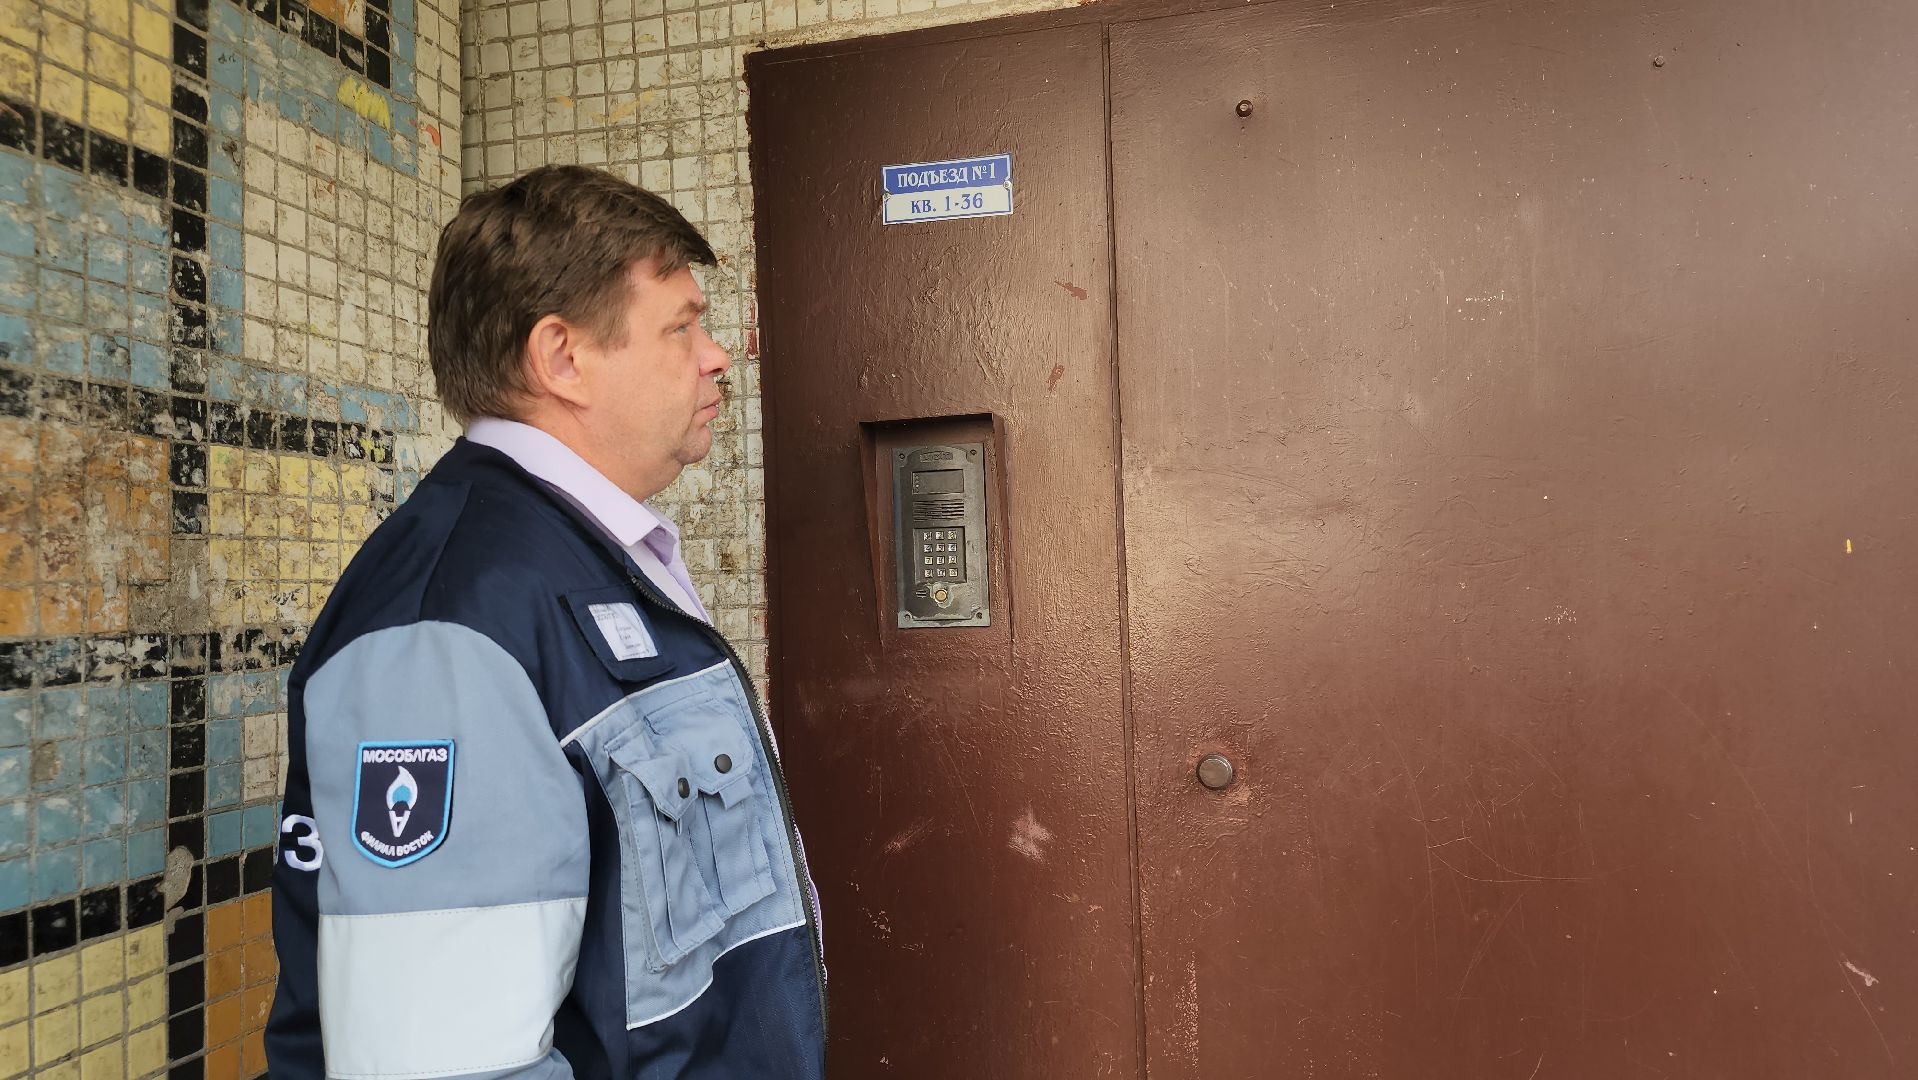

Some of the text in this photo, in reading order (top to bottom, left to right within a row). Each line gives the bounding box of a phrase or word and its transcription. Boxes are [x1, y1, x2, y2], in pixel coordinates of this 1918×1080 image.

[897, 167, 969, 189] ПОДЪЕЗД
[944, 192, 984, 212] 1-36
[362, 747, 448, 763] МОСОБЛГАЗ
[360, 830, 435, 857] ФИЛИАЛ ВОСТОК
